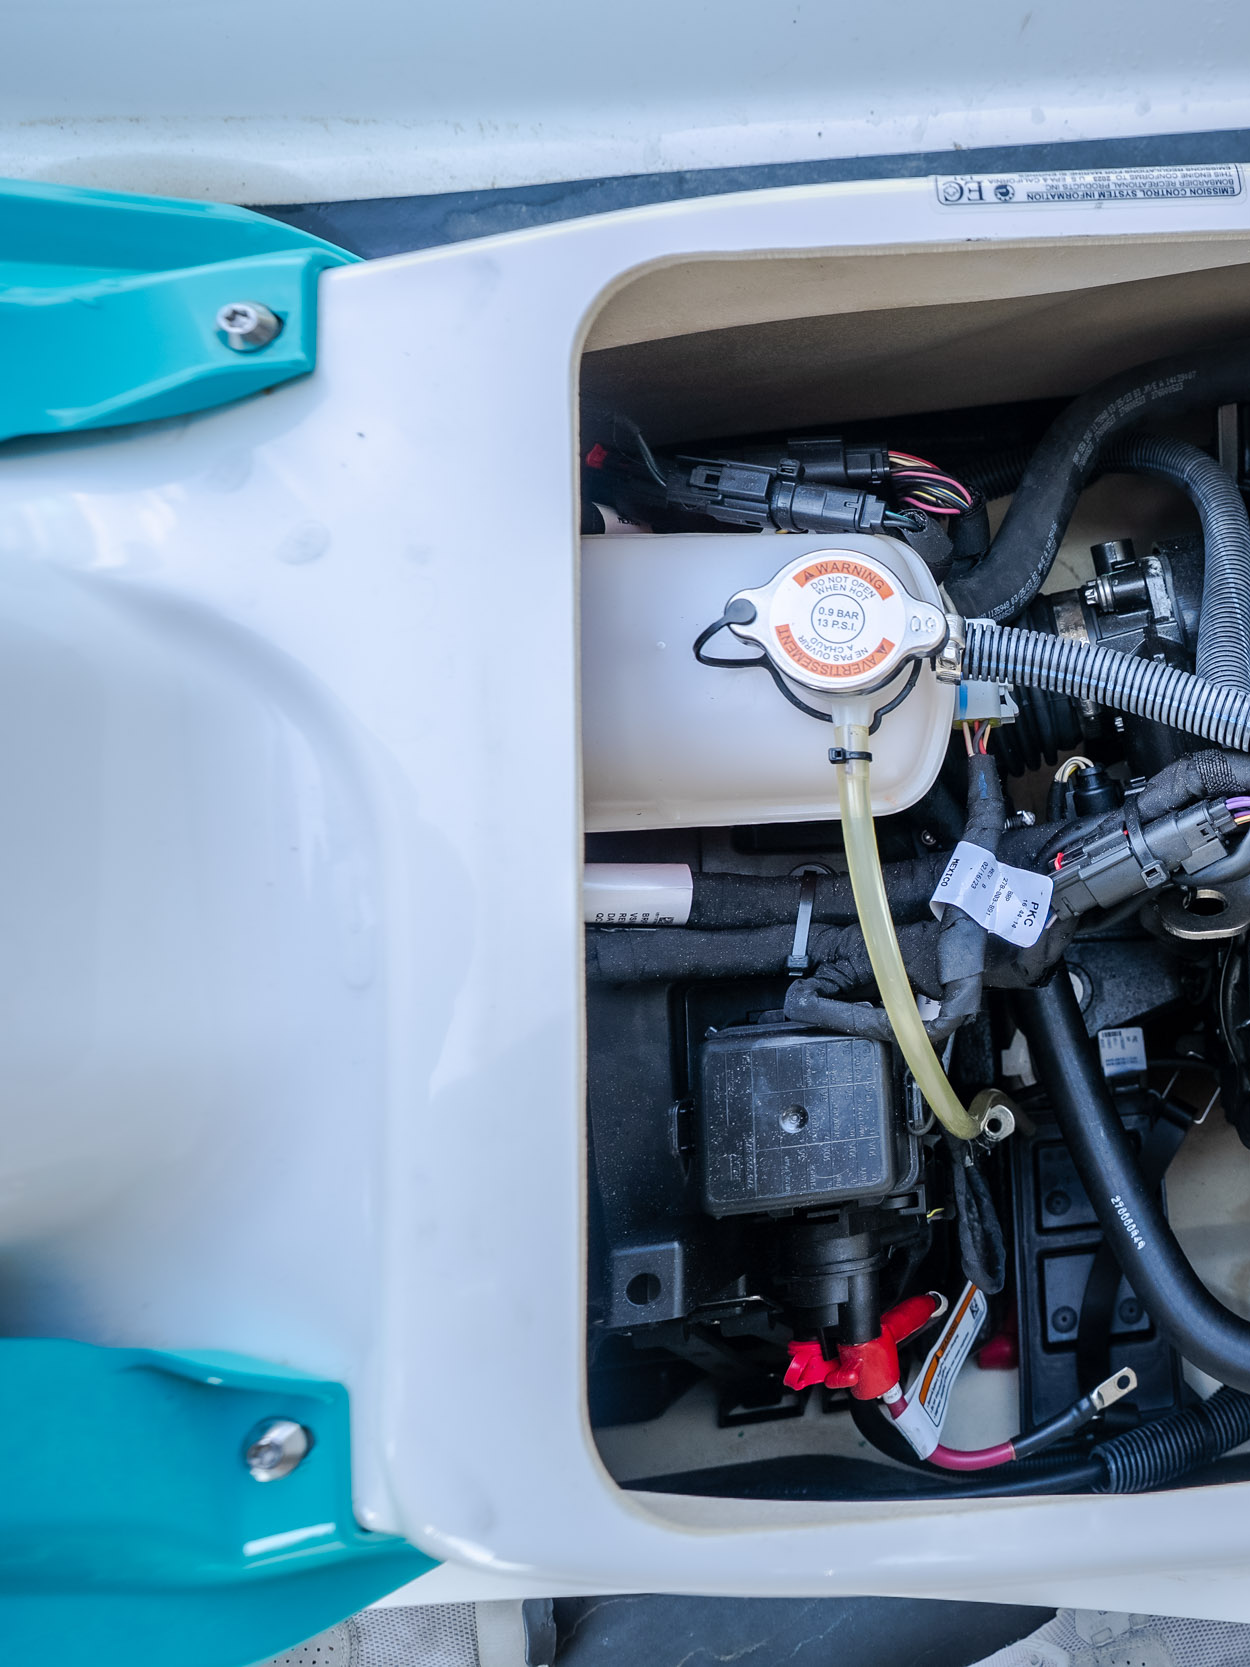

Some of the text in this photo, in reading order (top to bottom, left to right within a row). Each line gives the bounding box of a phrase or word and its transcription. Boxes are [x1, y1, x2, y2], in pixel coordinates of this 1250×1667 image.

[987, 177, 1039, 185] CALIFORNIA
[1128, 172, 1177, 180] CONFORMS
[1178, 178, 1233, 186] BOMBARDIER
[1064, 181, 1110, 190] PRODUCTS
[1113, 180, 1176, 189] RECREATIONAL
[1026, 186, 1234, 200] EMISSION CONTROL SYSTEM INFORMATION
[816, 562, 885, 591] WARNING
[810, 579, 824, 590] DO
[851, 579, 876, 599] OPEN
[815, 584, 870, 601] WHEN HOT
[818, 606, 859, 620] 0.9 BAR
[817, 619, 857, 631] 13 P.S.I.
[778, 628, 877, 676] AVERTISSEMENT
[797, 635, 869, 661] NE PAS OUVRIR
[809, 637, 845, 653] CHAUD
[941, 858, 960, 887] MEXICO
[971, 861, 988, 890] 02/16/23
[987, 867, 995, 880] REV
[986, 877, 1008, 916] 278-003-891
[1005, 891, 1013, 902] BRP
[1023, 901, 1039, 927] PKC
[1108, 1194, 1148, 1250] 270000949
